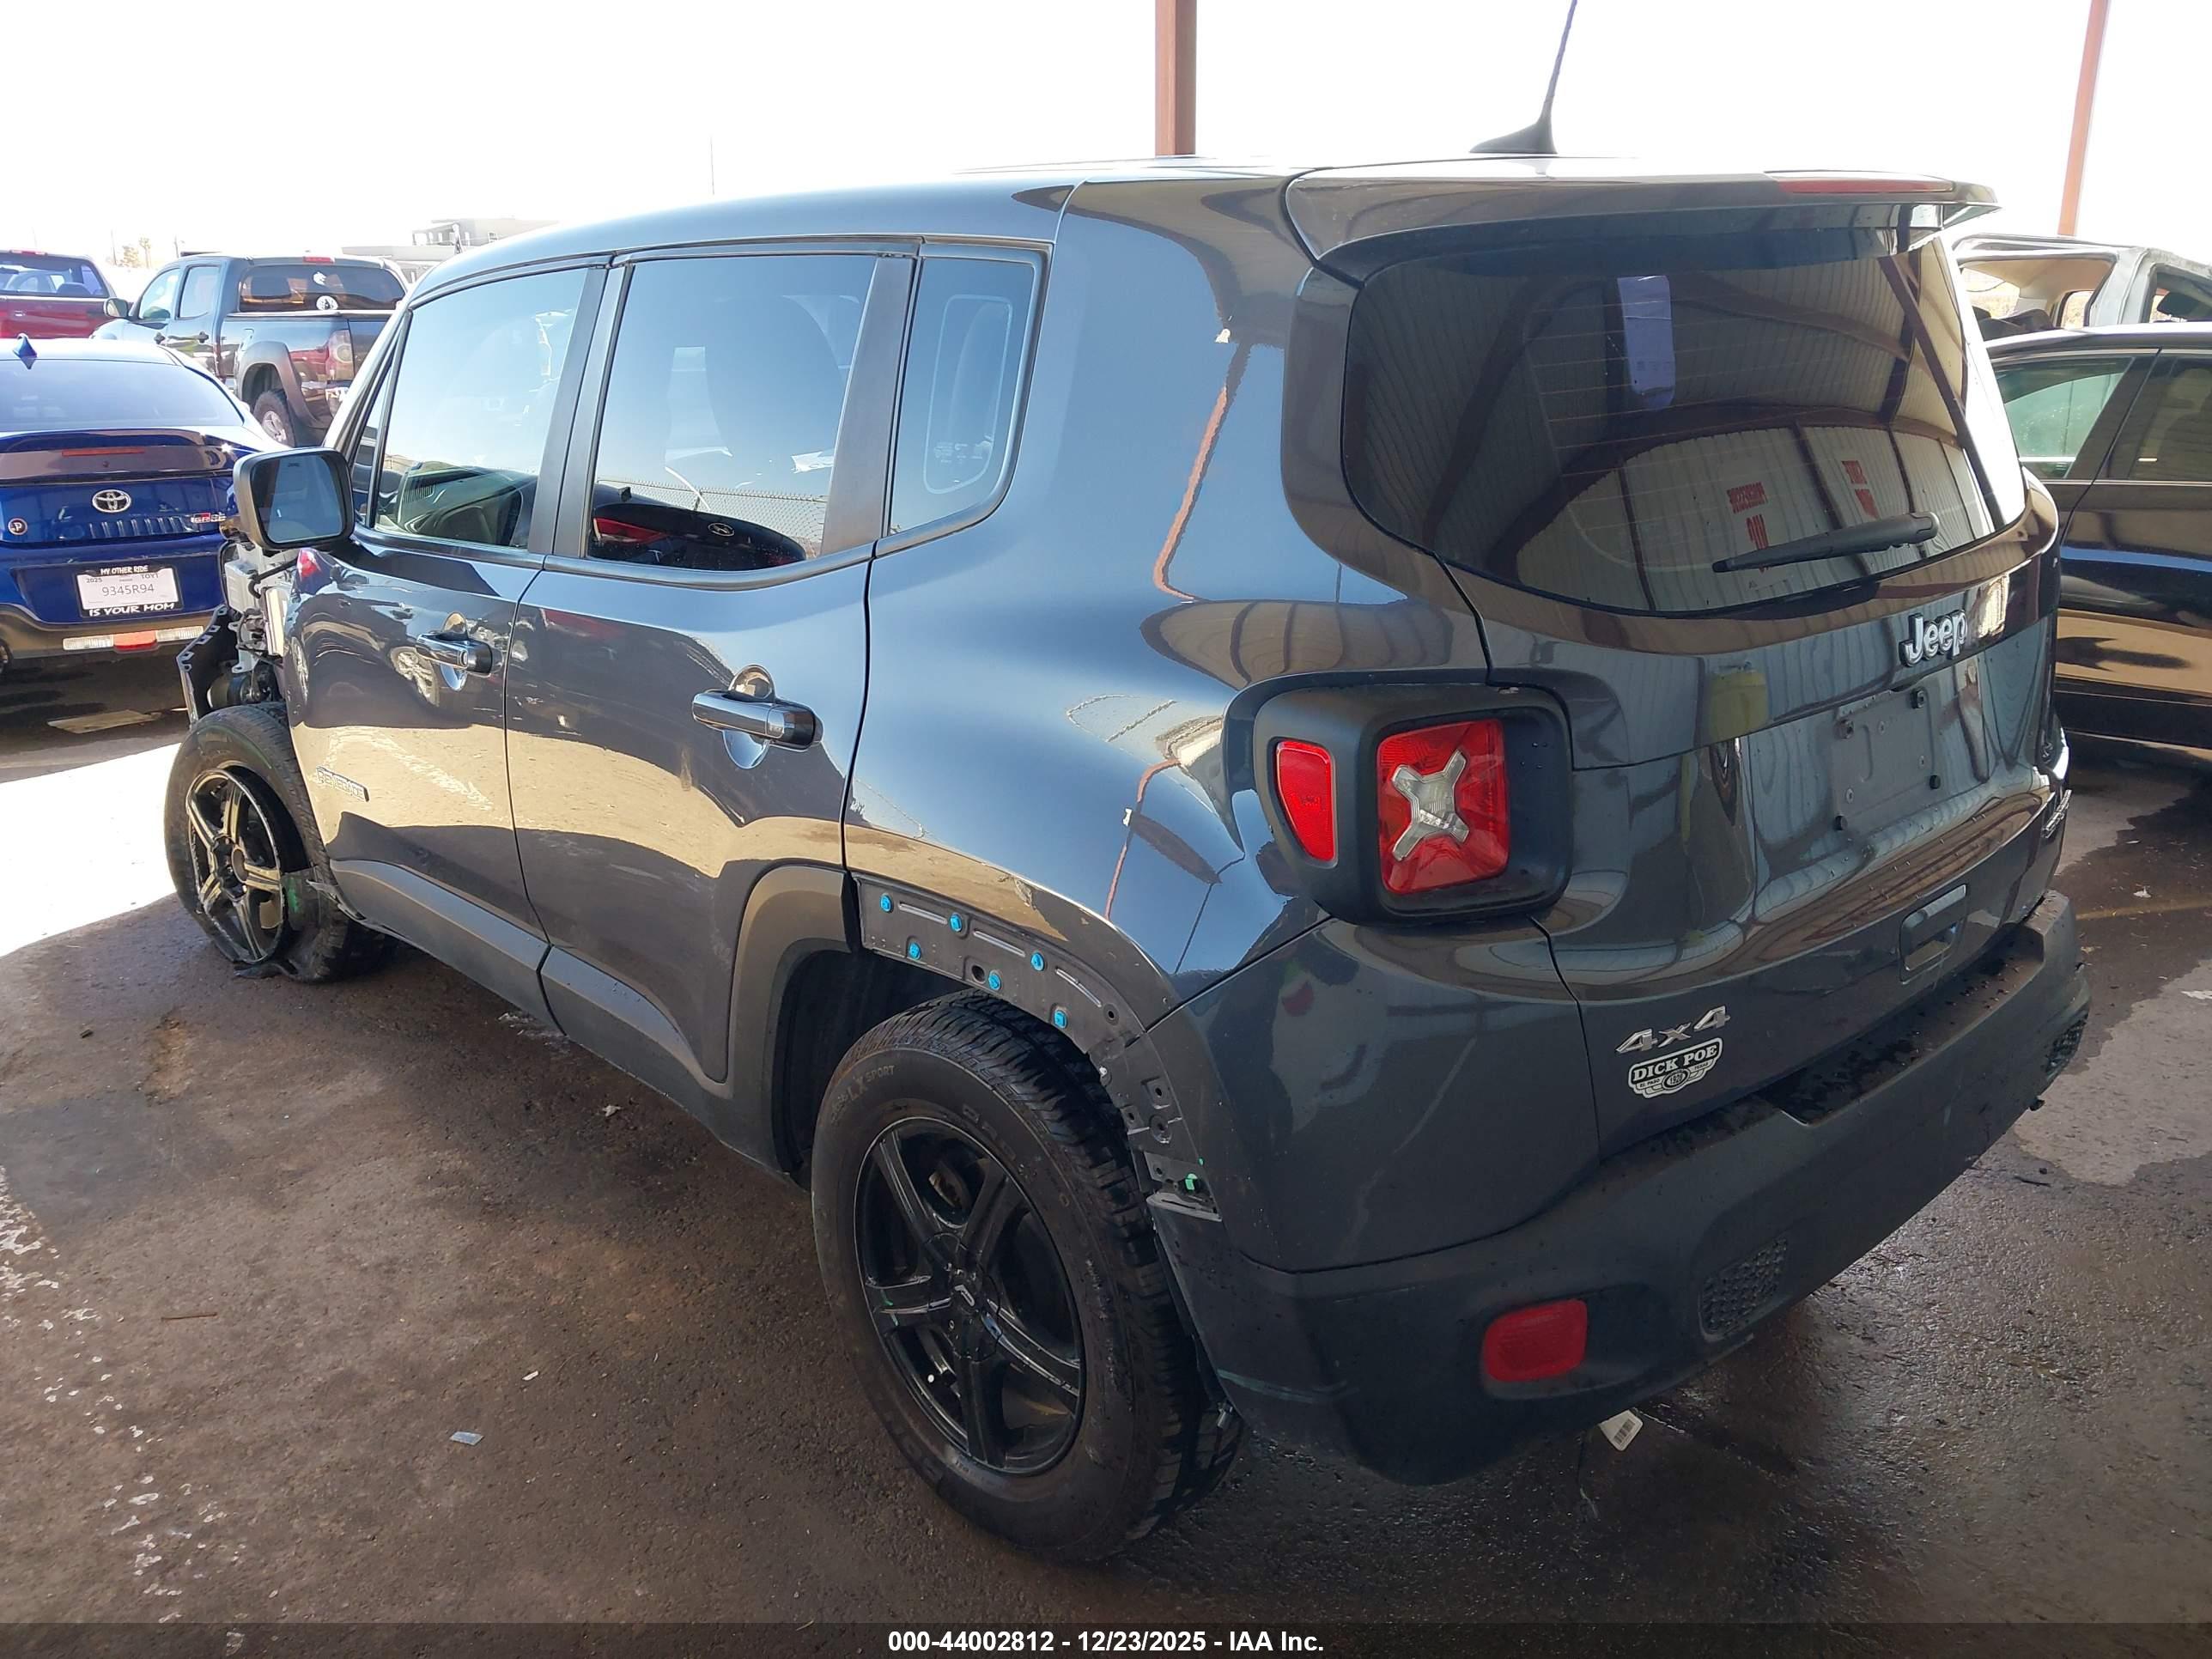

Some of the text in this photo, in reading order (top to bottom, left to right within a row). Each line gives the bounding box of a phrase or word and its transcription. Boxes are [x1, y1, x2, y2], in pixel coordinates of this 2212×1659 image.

[112, 566, 132, 574] OTHER
[133, 564, 149, 573] RIDE
[101, 583, 155, 597] 9345R94
[104, 605, 140, 614] YOUR
[143, 602, 174, 611] MOM
[1899, 610, 1967, 666] Jeep
[1633, 1044, 1717, 1082] DICK POE
